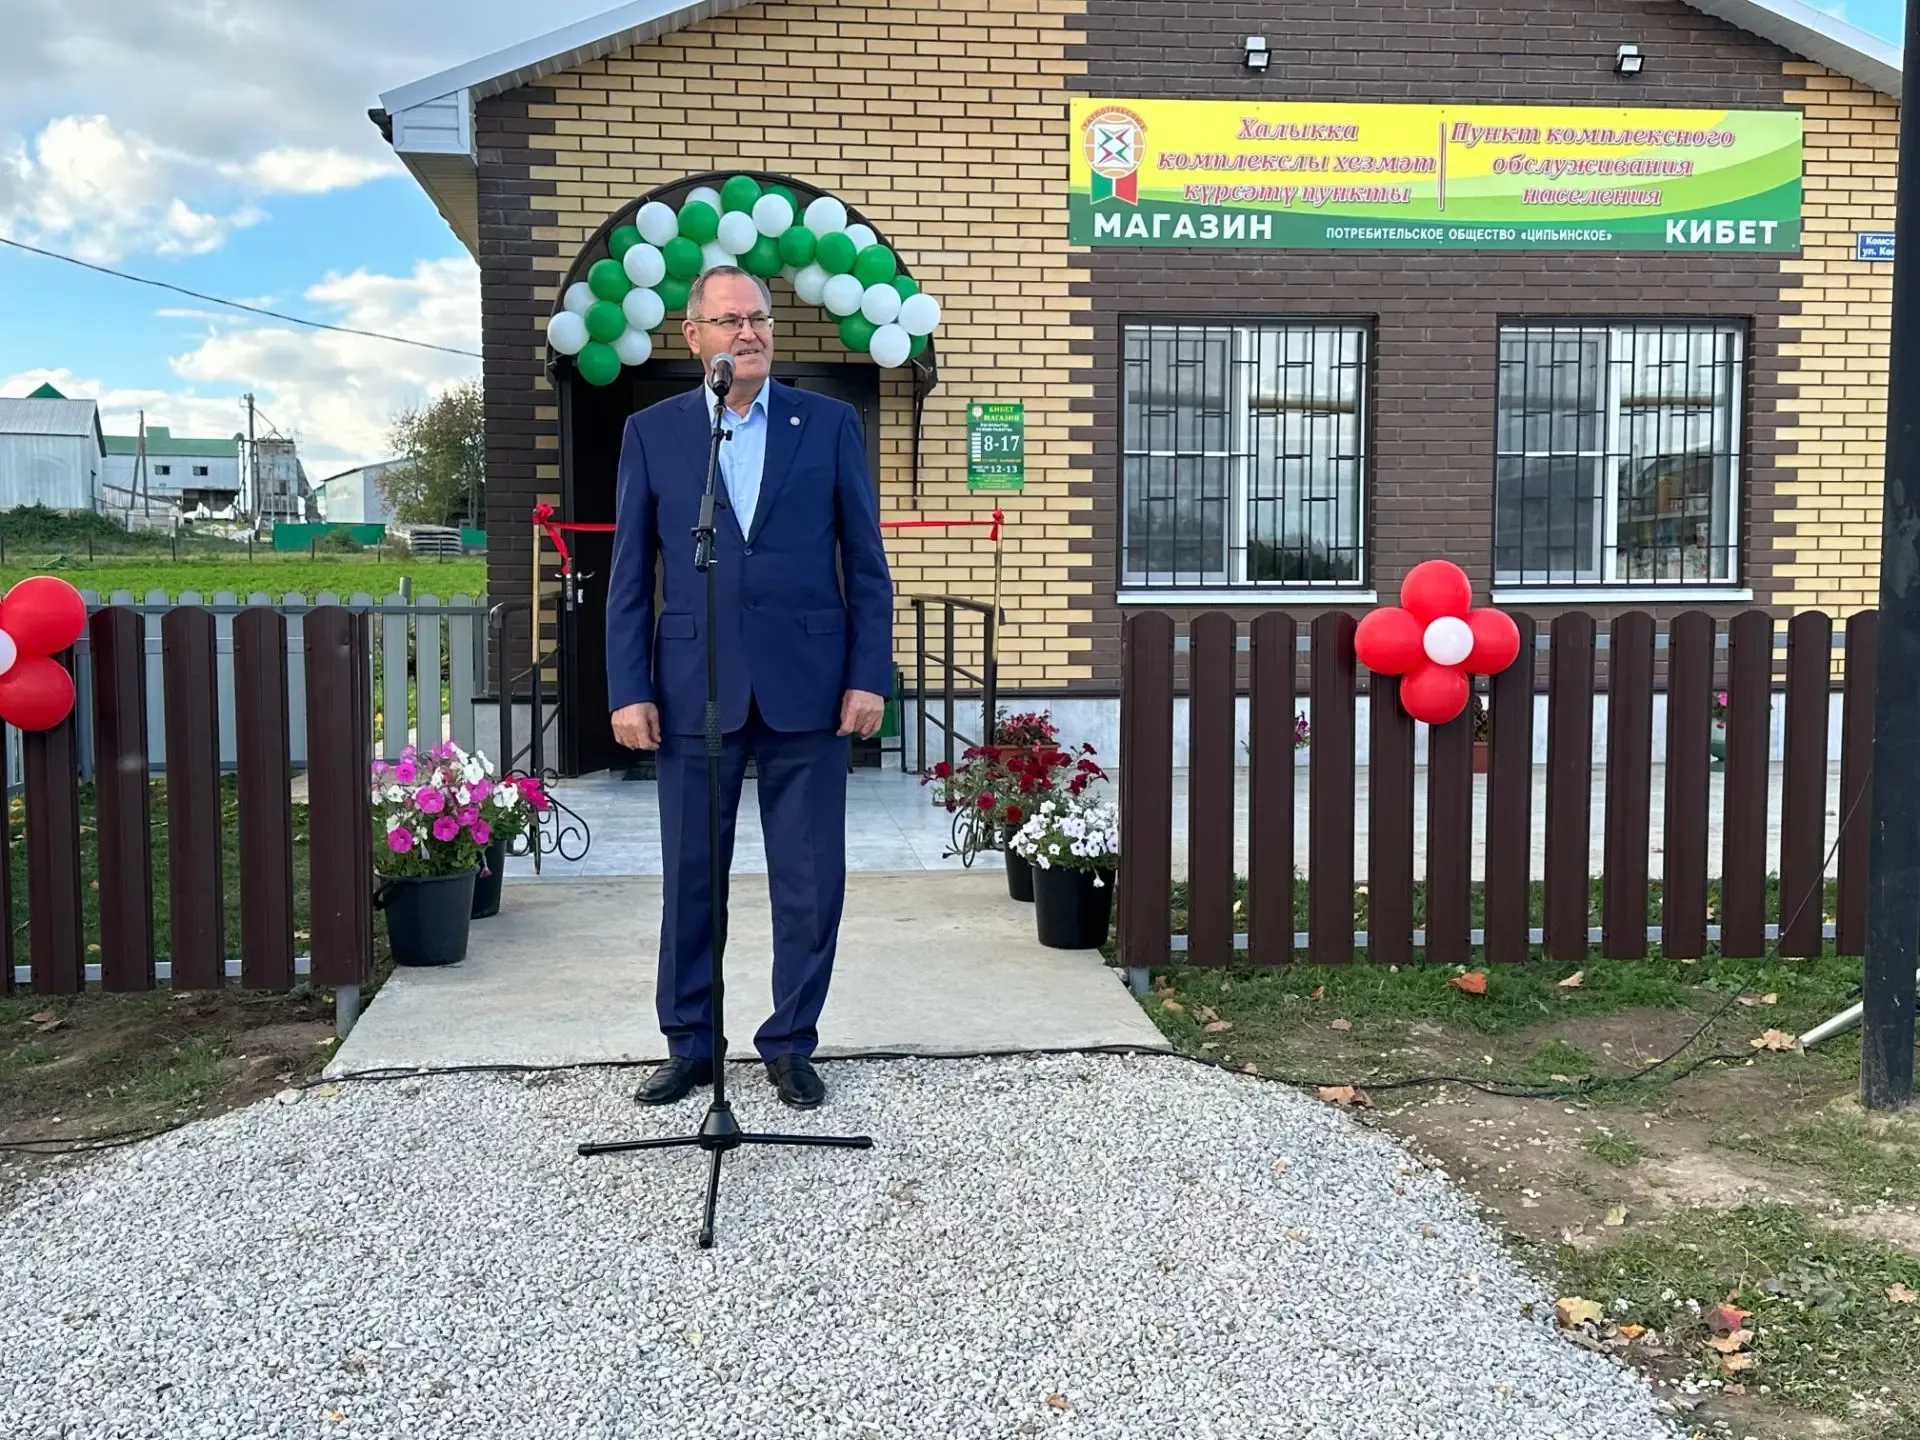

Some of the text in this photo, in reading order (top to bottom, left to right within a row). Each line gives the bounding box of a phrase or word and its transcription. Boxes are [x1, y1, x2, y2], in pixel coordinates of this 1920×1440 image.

[1236, 117, 1359, 141] Халыкка
[1450, 121, 1735, 147] Пункт комплексного
[1157, 151, 1437, 174] комплекслы хезмәт
[1492, 153, 1694, 179] обслуживания
[1183, 183, 1411, 208] күрсәтү пункты
[1522, 185, 1663, 207] населения
[1093, 212, 1273, 240] МАГАЗИН
[1326, 227, 1613, 242] ПОТРЕБИТЕЛЬСКОЕ ОБЩЕСТВО «ЦИПЬИНСКОЕ»
[1665, 219, 1778, 245] КИБЕТ
[1862, 248, 1877, 257] ул.
[984, 435, 1020, 452] 8-17
[991, 465, 1018, 473] 12-13
